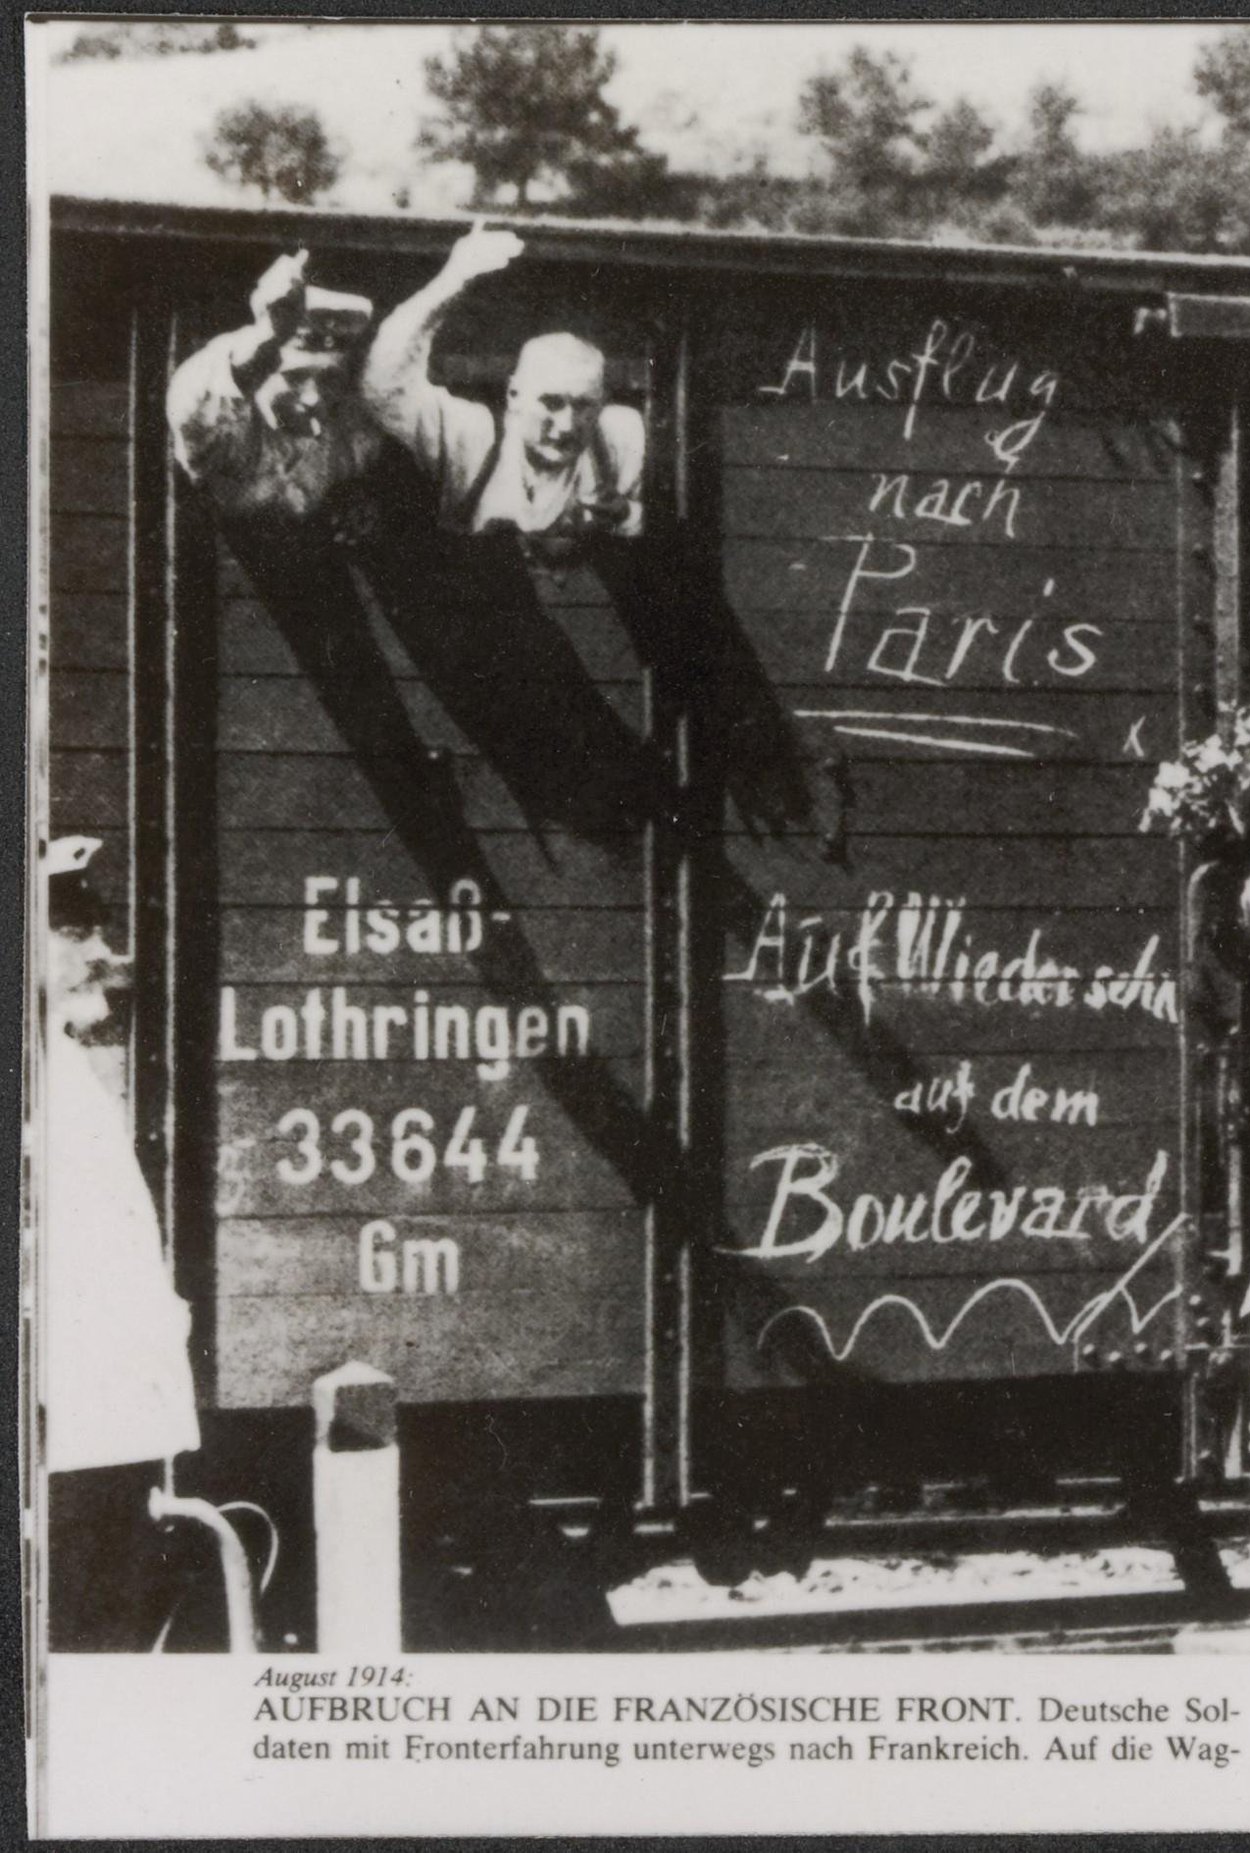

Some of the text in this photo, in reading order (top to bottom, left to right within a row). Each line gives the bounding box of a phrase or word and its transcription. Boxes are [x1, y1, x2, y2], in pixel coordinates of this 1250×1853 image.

[759, 319, 1058, 475] Ausflug
[868, 473, 1021, 538] nach
[820, 532, 1103, 687] Paris
[303, 876, 511, 955] Elsaß-
[722, 892, 895, 1027] Auf
[218, 986, 592, 1081] Lothringen
[894, 1060, 1100, 1134] auf dem
[275, 1105, 540, 1185] 33644
[714, 1143, 1168, 1263] Boulevard
[358, 1220, 461, 1295] Gm
